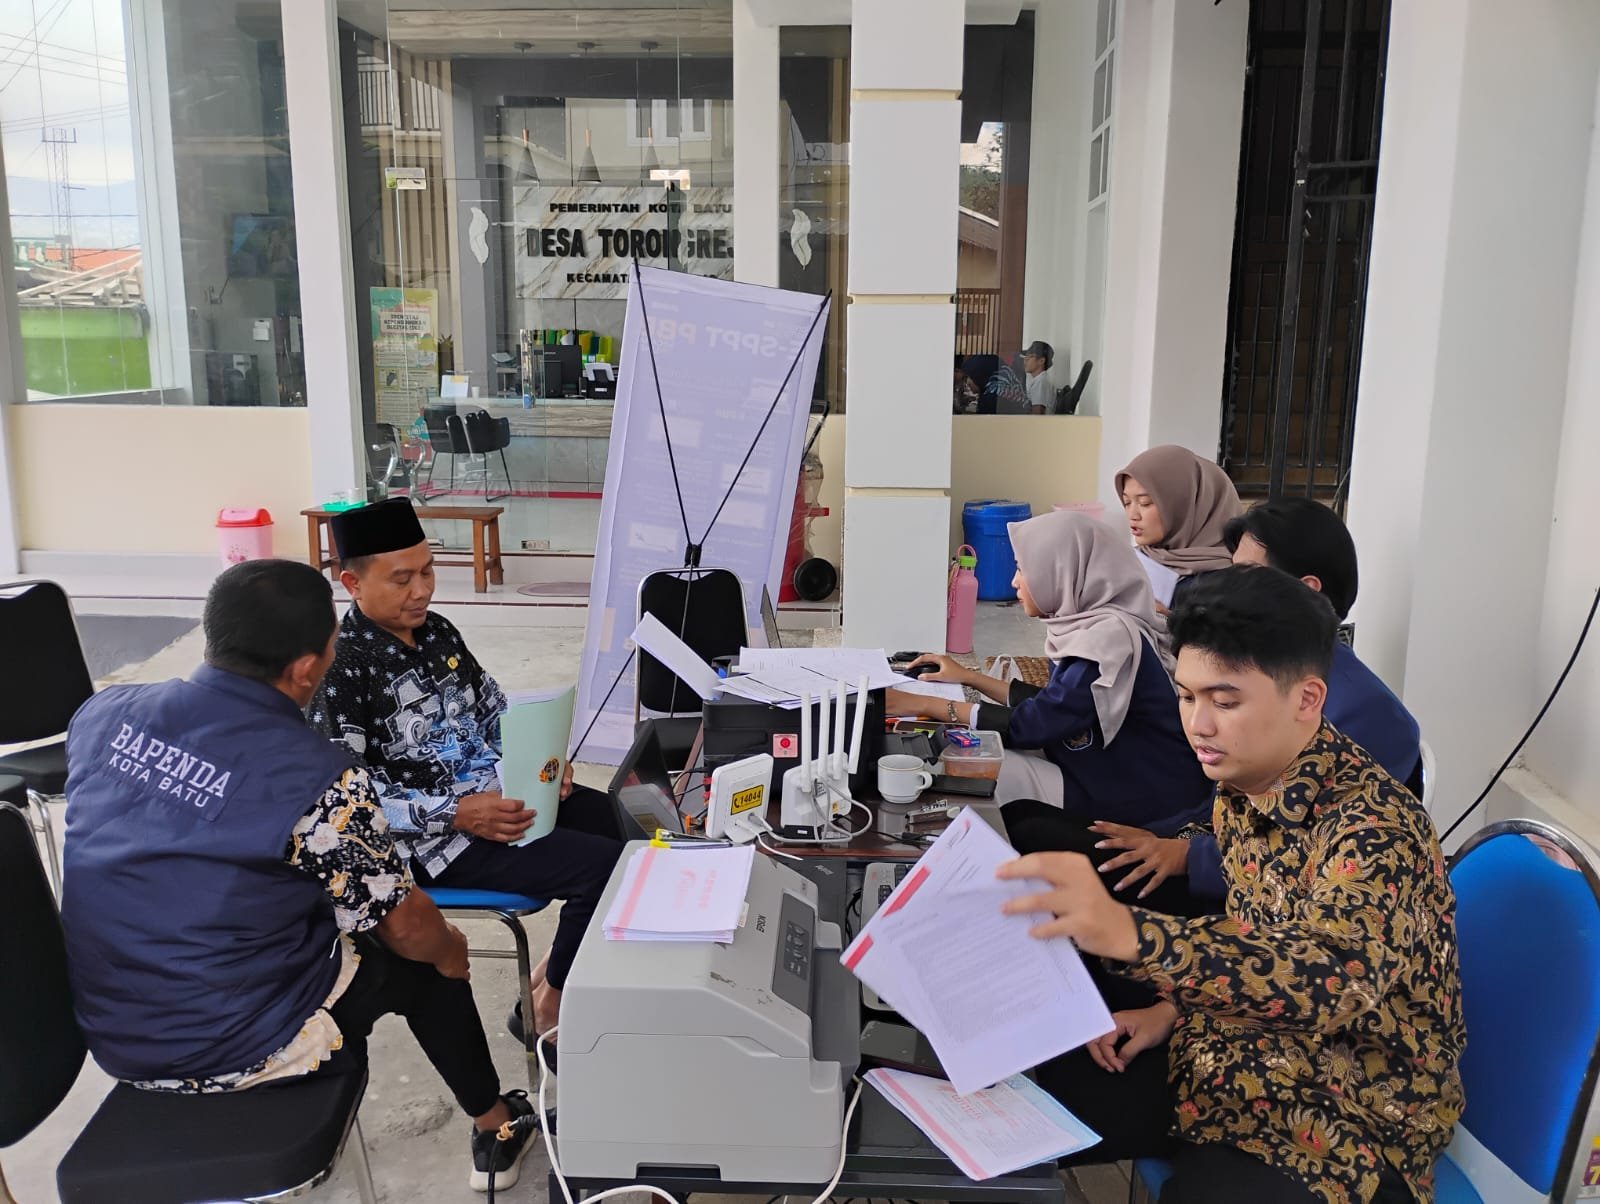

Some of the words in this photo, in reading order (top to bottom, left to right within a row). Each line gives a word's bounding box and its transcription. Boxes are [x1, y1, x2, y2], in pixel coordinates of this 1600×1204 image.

[550, 203, 640, 213] PEMERINTAH
[694, 203, 732, 213] BATU
[526, 228, 586, 258] DESA
[108, 752, 151, 783] KOTA
[158, 776, 210, 808] BATU
[110, 723, 232, 799] BAPENDA
